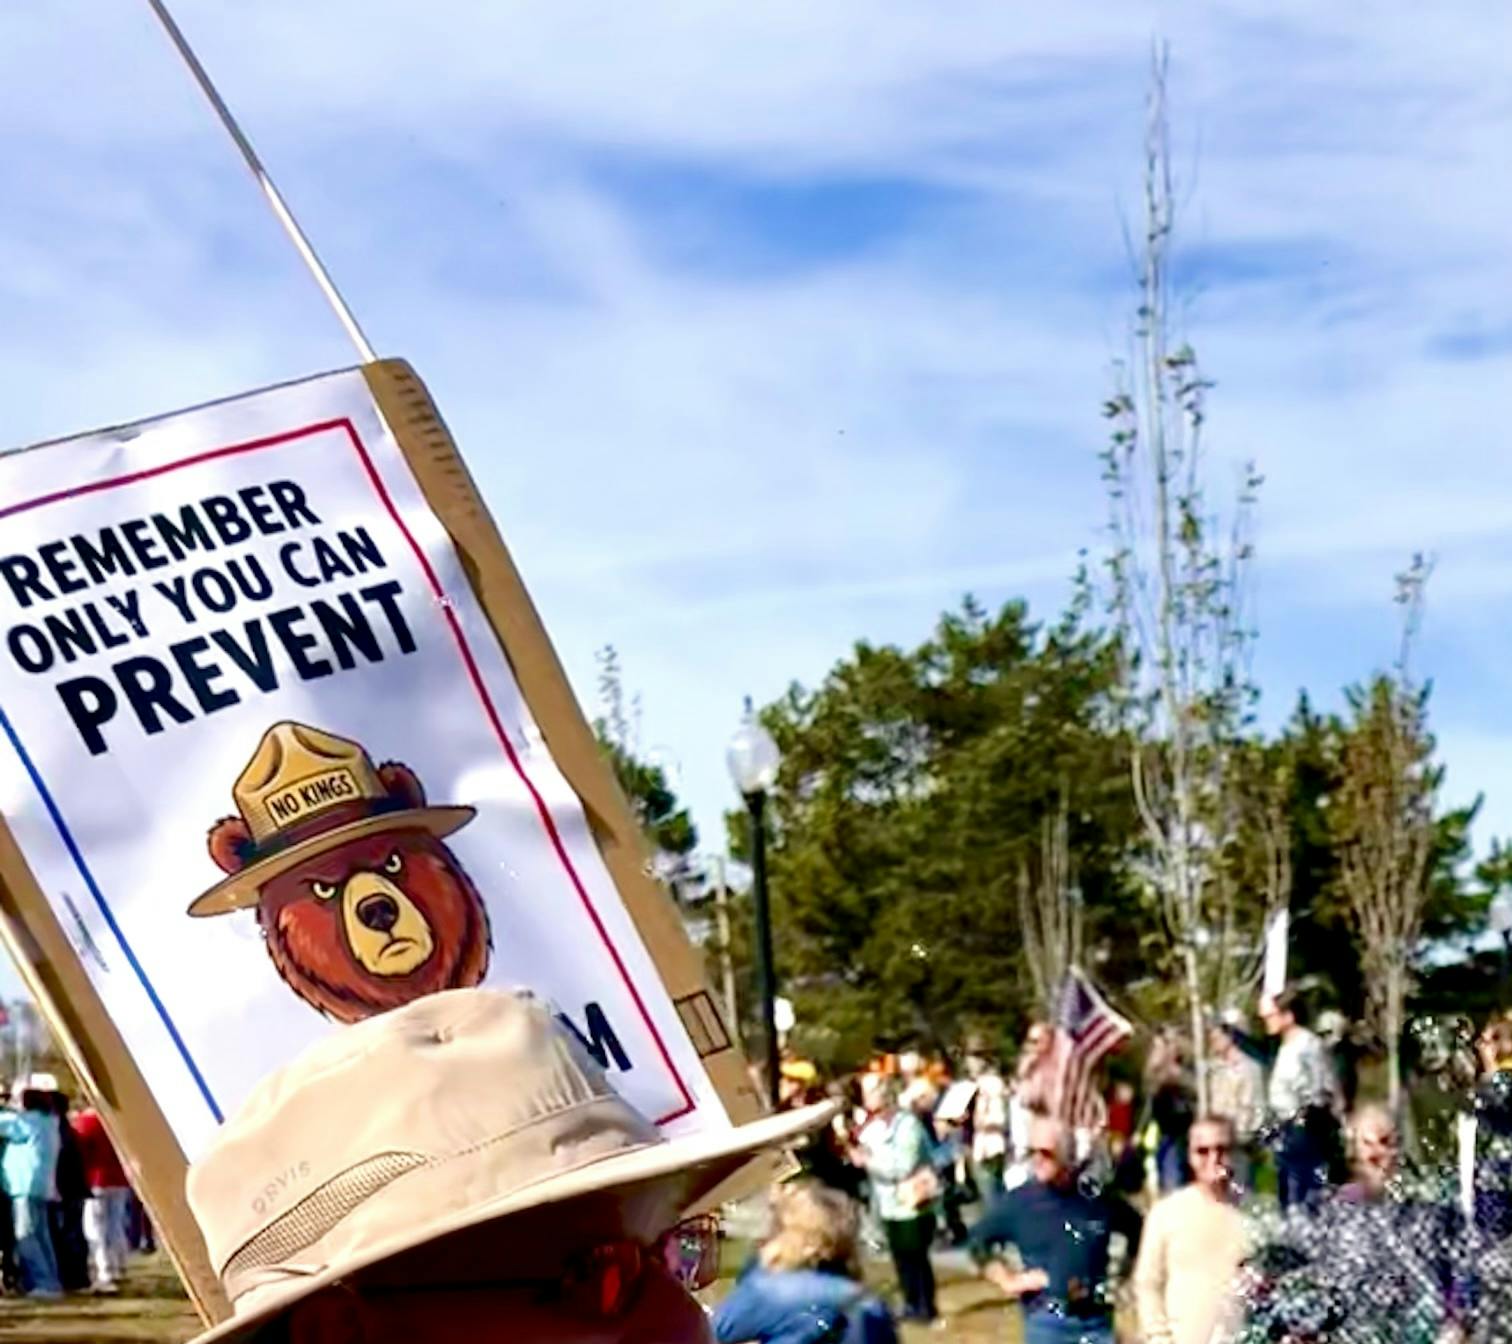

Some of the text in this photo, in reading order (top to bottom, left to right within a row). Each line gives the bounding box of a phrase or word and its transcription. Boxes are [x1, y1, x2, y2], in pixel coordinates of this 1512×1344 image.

[0, 480, 321, 608] REMEMBER
[7, 527, 387, 674] ONLY YOU CAN
[56, 580, 417, 756] PREVENT
[272, 774, 353, 820] NO KINGS
[251, 1161, 311, 1214] ORVIS
